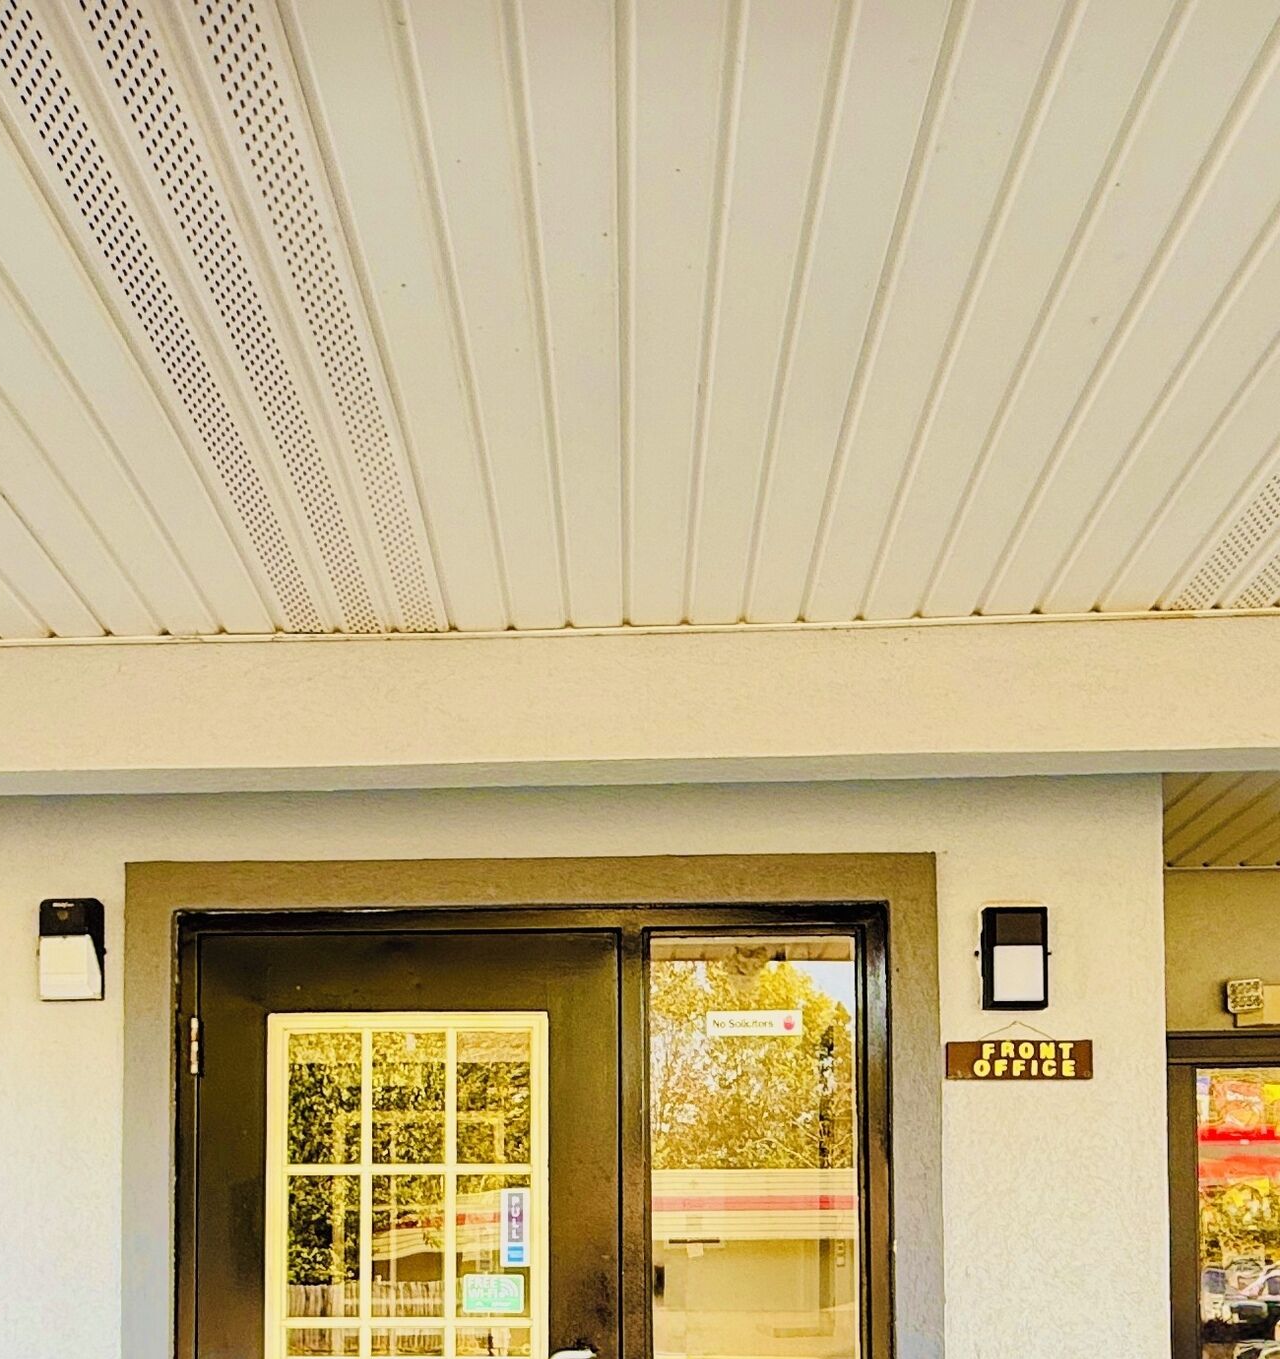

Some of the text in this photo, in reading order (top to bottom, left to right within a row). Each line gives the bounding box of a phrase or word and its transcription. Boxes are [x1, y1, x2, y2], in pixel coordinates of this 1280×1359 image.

[712, 1019, 725, 1028] No
[982, 1041, 1074, 1060] FRONT
[973, 1059, 1076, 1077] OFFICE
[511, 1194, 521, 1240] PULL
[467, 1277, 498, 1288] FREE
